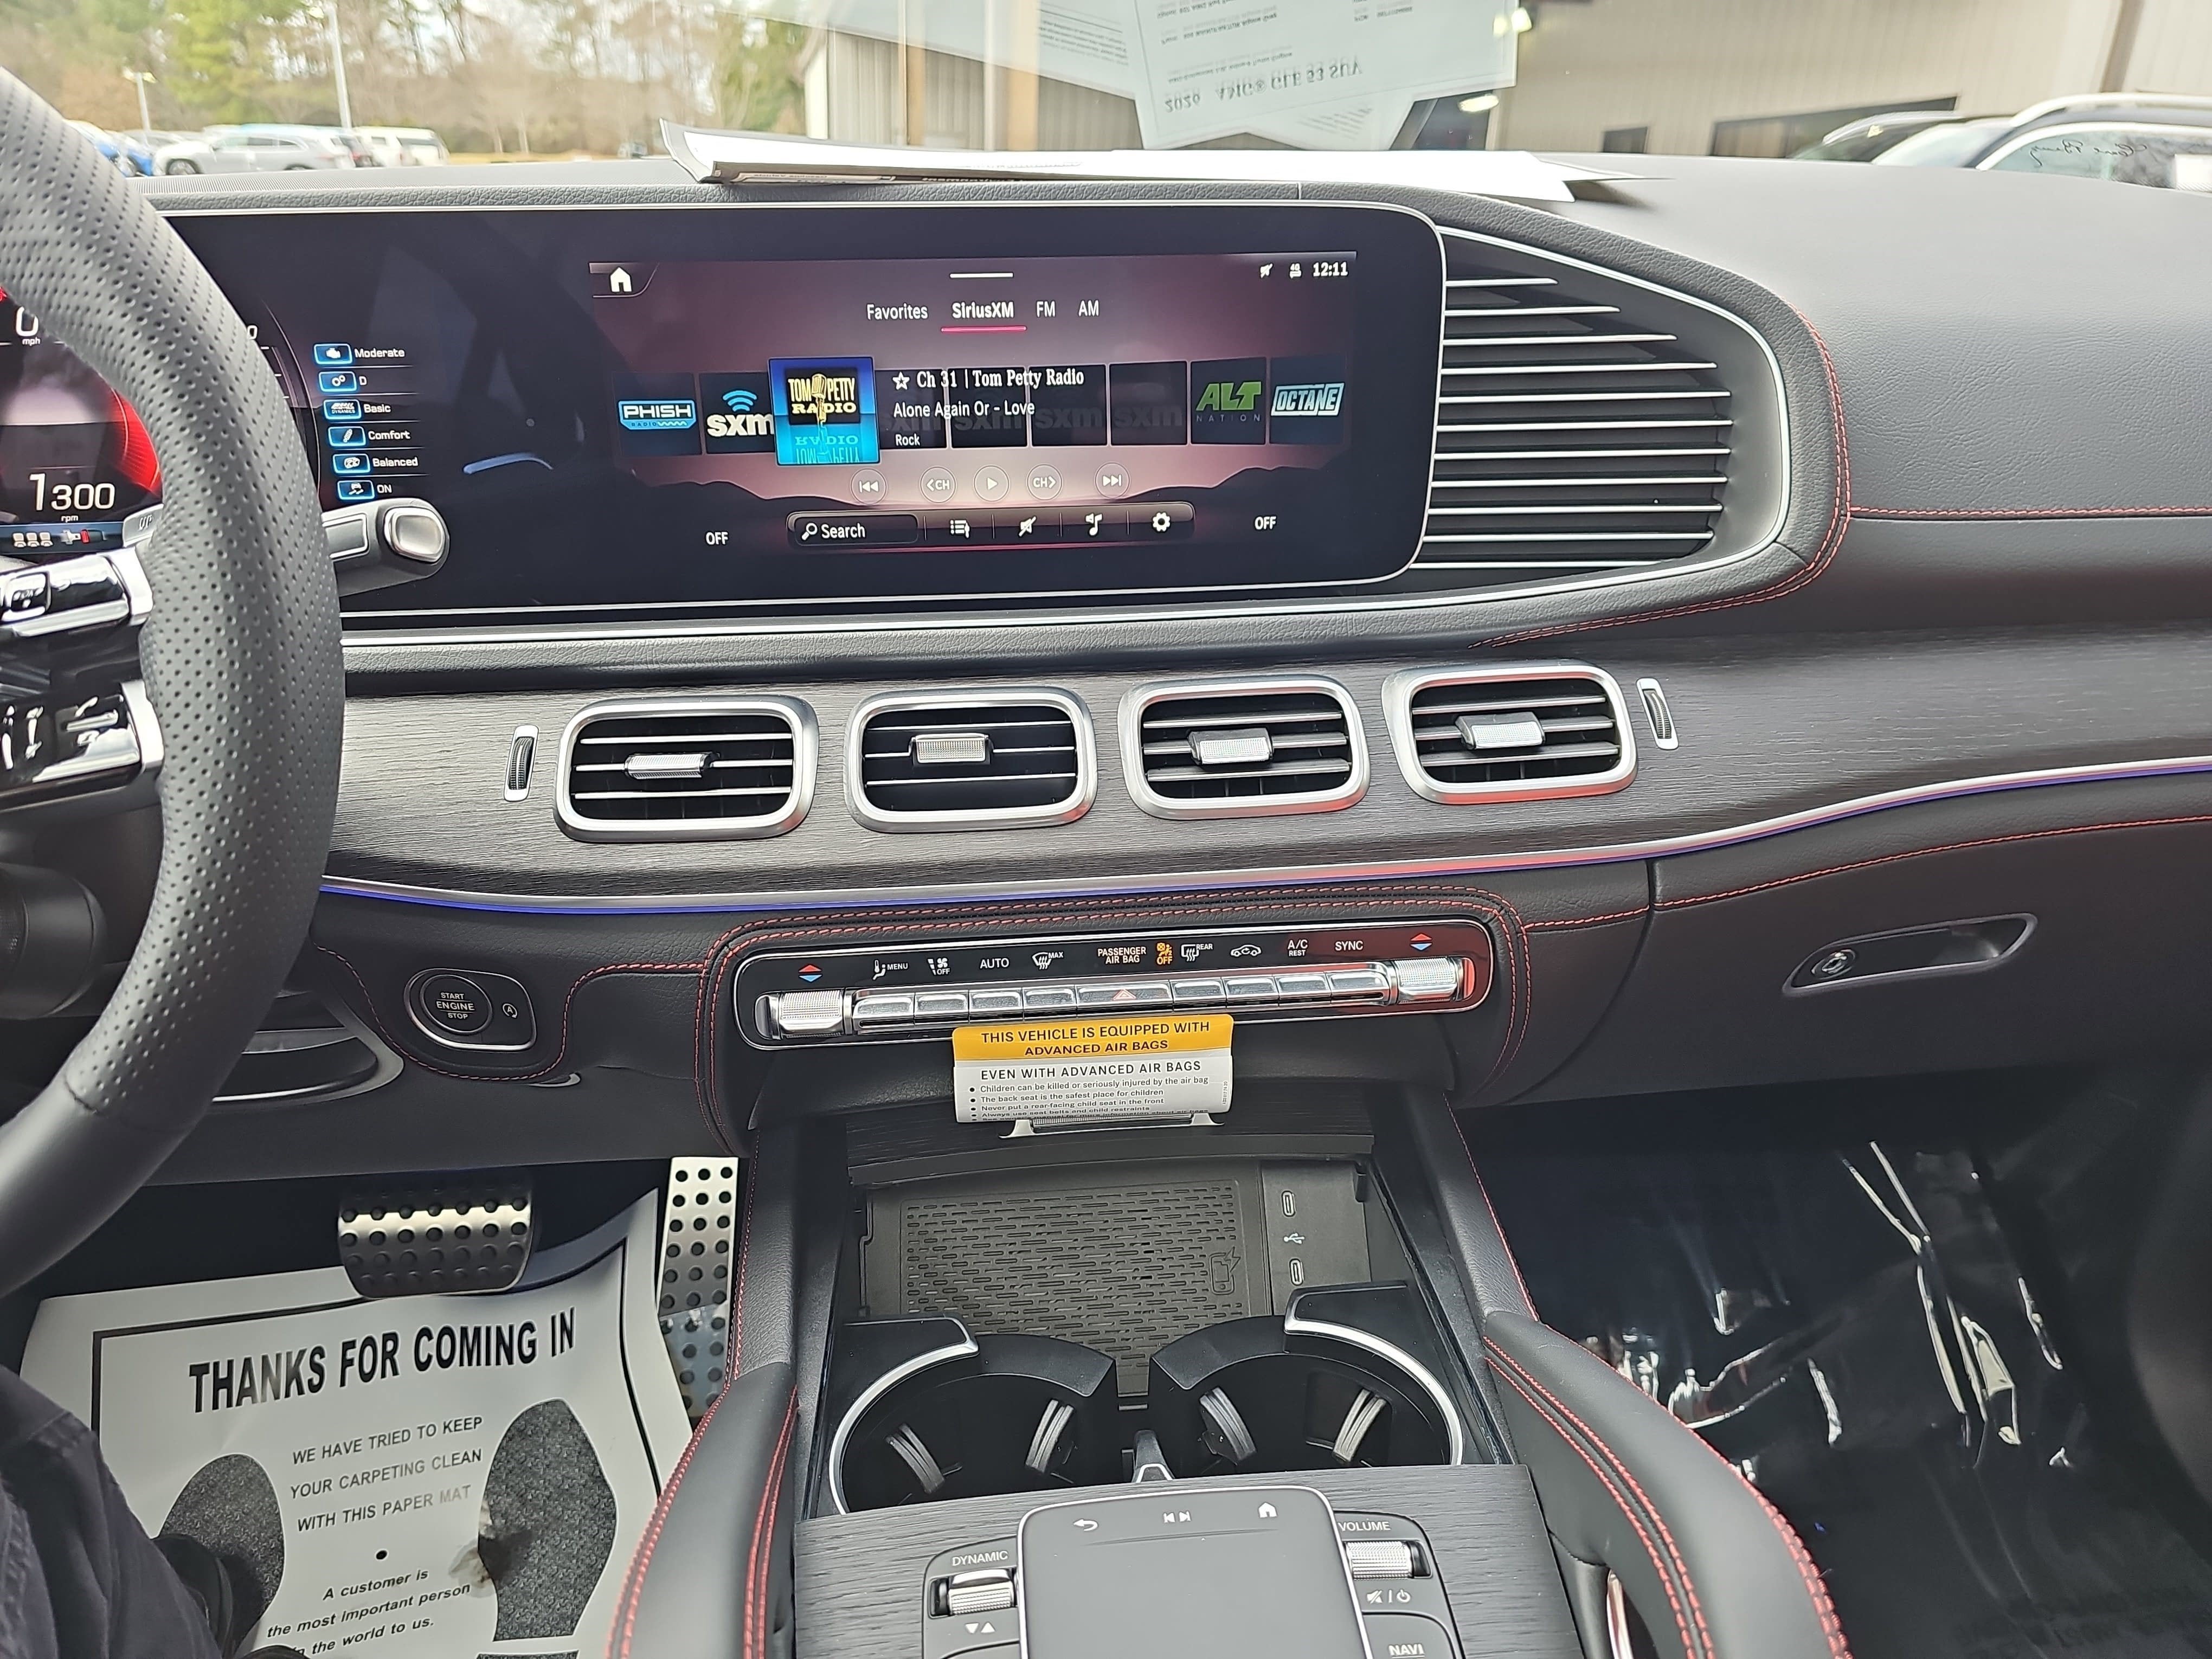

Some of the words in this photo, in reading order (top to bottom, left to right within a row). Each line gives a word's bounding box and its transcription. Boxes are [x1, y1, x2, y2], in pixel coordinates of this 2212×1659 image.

[1313, 262, 1348, 277] 12:11
[867, 303, 928, 320] Favorites
[952, 301, 1014, 319] SiriusXM
[1037, 301, 1056, 317] FM
[1078, 300, 1099, 317] AM
[22, 338, 41, 346] mph
[354, 349, 405, 358] Moderate
[359, 376, 367, 385] D
[917, 371, 935, 388] Ch
[941, 370, 957, 388] 31
[973, 370, 1004, 387] Tom
[1007, 369, 1041, 390] Petty
[1046, 368, 1084, 385] Radio
[788, 378, 810, 402] TOM
[827, 378, 856, 401] PETTY
[1196, 381, 1261, 410] ALT
[1276, 388, 1338, 411] OCTANE
[363, 404, 391, 413] Basic
[623, 404, 692, 419] PHISH
[792, 403, 857, 414] RADIO
[893, 402, 930, 417] Alone
[935, 401, 970, 420] Again
[974, 401, 990, 414] Or
[1004, 400, 1035, 415] Love
[707, 414, 774, 437] sxm
[368, 430, 410, 440] Comfort
[895, 433, 921, 446] Rock
[372, 457, 418, 467] Balanced
[29, 473, 115, 511] 1300
[377, 485, 392, 493] ON
[61, 515, 79, 524] rpm
[1255, 516, 1276, 530] OFF
[821, 522, 866, 539] Search
[706, 531, 728, 545] OFF
[1098, 947, 1147, 956] PASSENGER
[1288, 940, 1308, 949] A/C
[1335, 941, 1364, 950] SYNC
[980, 958, 1009, 969] AUTO
[1105, 956, 1120, 964] AIR
[1123, 955, 1140, 963] BAG
[1157, 956, 1173, 964] OFF
[436, 1001, 475, 1011] ENGINE
[981, 1032, 1014, 1043] THIS
[1018, 1028, 1078, 1041] VEHICLE
[1082, 1027, 1095, 1038] IS
[1100, 1024, 1169, 1037] EQUIPPED
[1174, 1021, 1210, 1033] WITH
[1025, 1044, 1101, 1056] ADVANCED
[1105, 1043, 1128, 1052] AIR
[1133, 1040, 1168, 1051] BAGS
[981, 1069, 1015, 1080] EVEN
[1021, 1068, 1055, 1078] WITH
[1061, 1064, 1134, 1077] ADVANCED
[1139, 1063, 1161, 1073] AIR
[1167, 1060, 1201, 1072] BAGS
[1083, 1080, 1120, 1088] seriously
[1122, 1079, 1150, 1087] injured
[1153, 1078, 1162, 1086] by
[1193, 1076, 1208, 1085] bag
[189, 1345, 326, 1413] THANKS
[340, 1331, 400, 1387] FOR
[414, 1320, 536, 1372] COMING
[550, 1307, 575, 1359] IN
[292, 1449, 316, 1465] WE
[321, 1439, 362, 1459] HAVE
[368, 1429, 411, 1450] TRIED
[417, 1424, 438, 1440] TO
[443, 1416, 483, 1435] KEEP
[291, 1480, 332, 1500] YOUR
[339, 1460, 426, 1489] CARPETING
[432, 1449, 483, 1470] CLEAN
[297, 1512, 336, 1532] WITH
[342, 1503, 376, 1523] THIS
[382, 1495, 433, 1516] PAPER
[439, 1484, 472, 1505] MAT
[1338, 1521, 1391, 1532] VOLUME
[953, 1551, 1008, 1566] DYNAMIC
[322, 1588, 334, 1601] A
[341, 1574, 412, 1597] customer
[416, 1570, 429, 1581] is
[267, 1624, 291, 1638] the
[297, 1615, 336, 1633] most
[341, 1596, 414, 1623] important
[417, 1584, 471, 1606] person
[312, 1641, 336, 1655] the
[343, 1626, 385, 1646] world
[391, 1622, 406, 1635] to
[412, 1617, 435, 1629] us.
[1388, 1643, 1424, 1657] NAVI
